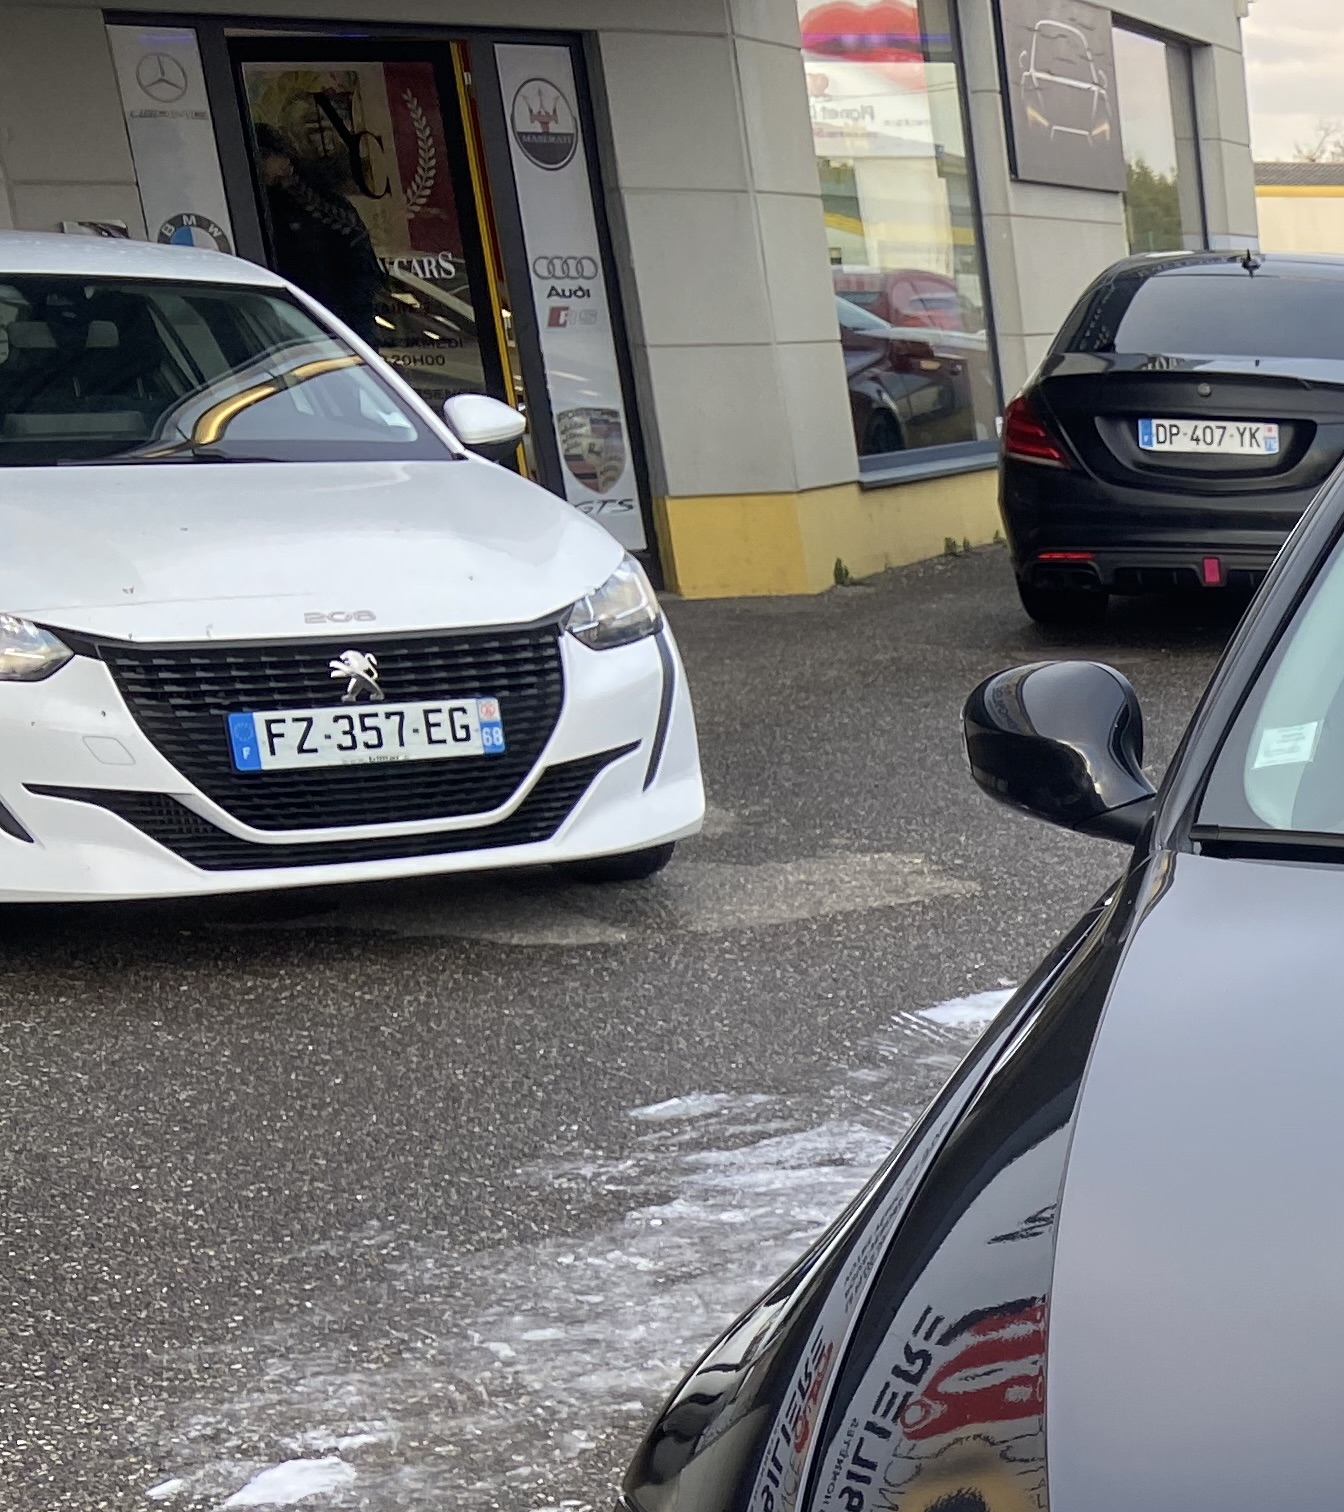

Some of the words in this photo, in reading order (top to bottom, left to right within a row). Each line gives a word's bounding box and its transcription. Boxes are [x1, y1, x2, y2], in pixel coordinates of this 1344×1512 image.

[162, 215, 223, 238] BMW
[546, 285, 591, 299] Audi
[1155, 423, 1261, 448] DP-407-YK
[574, 498, 634, 516] GTS
[264, 706, 472, 756] FZ-357-EG
[482, 727, 503, 746] 68
